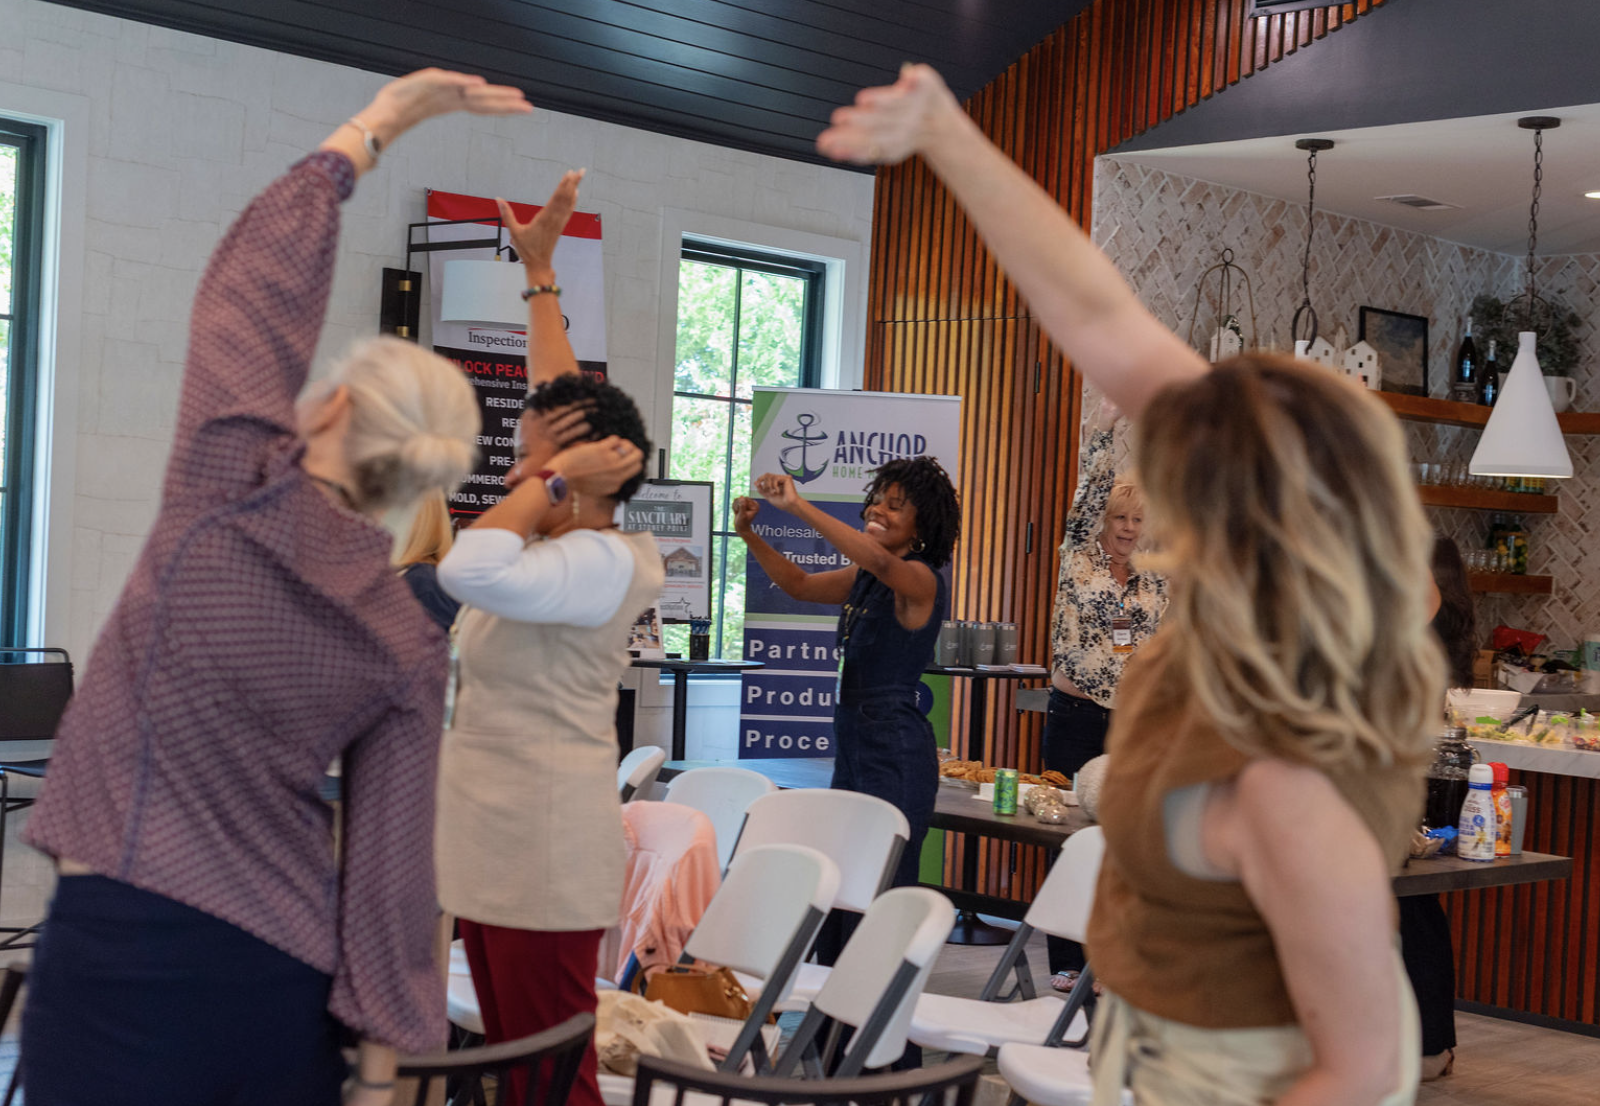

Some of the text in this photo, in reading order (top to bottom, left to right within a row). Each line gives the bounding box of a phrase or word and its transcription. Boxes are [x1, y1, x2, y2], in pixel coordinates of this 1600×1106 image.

[832, 465, 863, 478] HOME
[628, 510, 688, 525] SANCTUARY
[751, 523, 824, 539] Wholesale
[783, 551, 837, 566] Trusted
[747, 686, 832, 706] Produ
[745, 729, 830, 750] Proce
